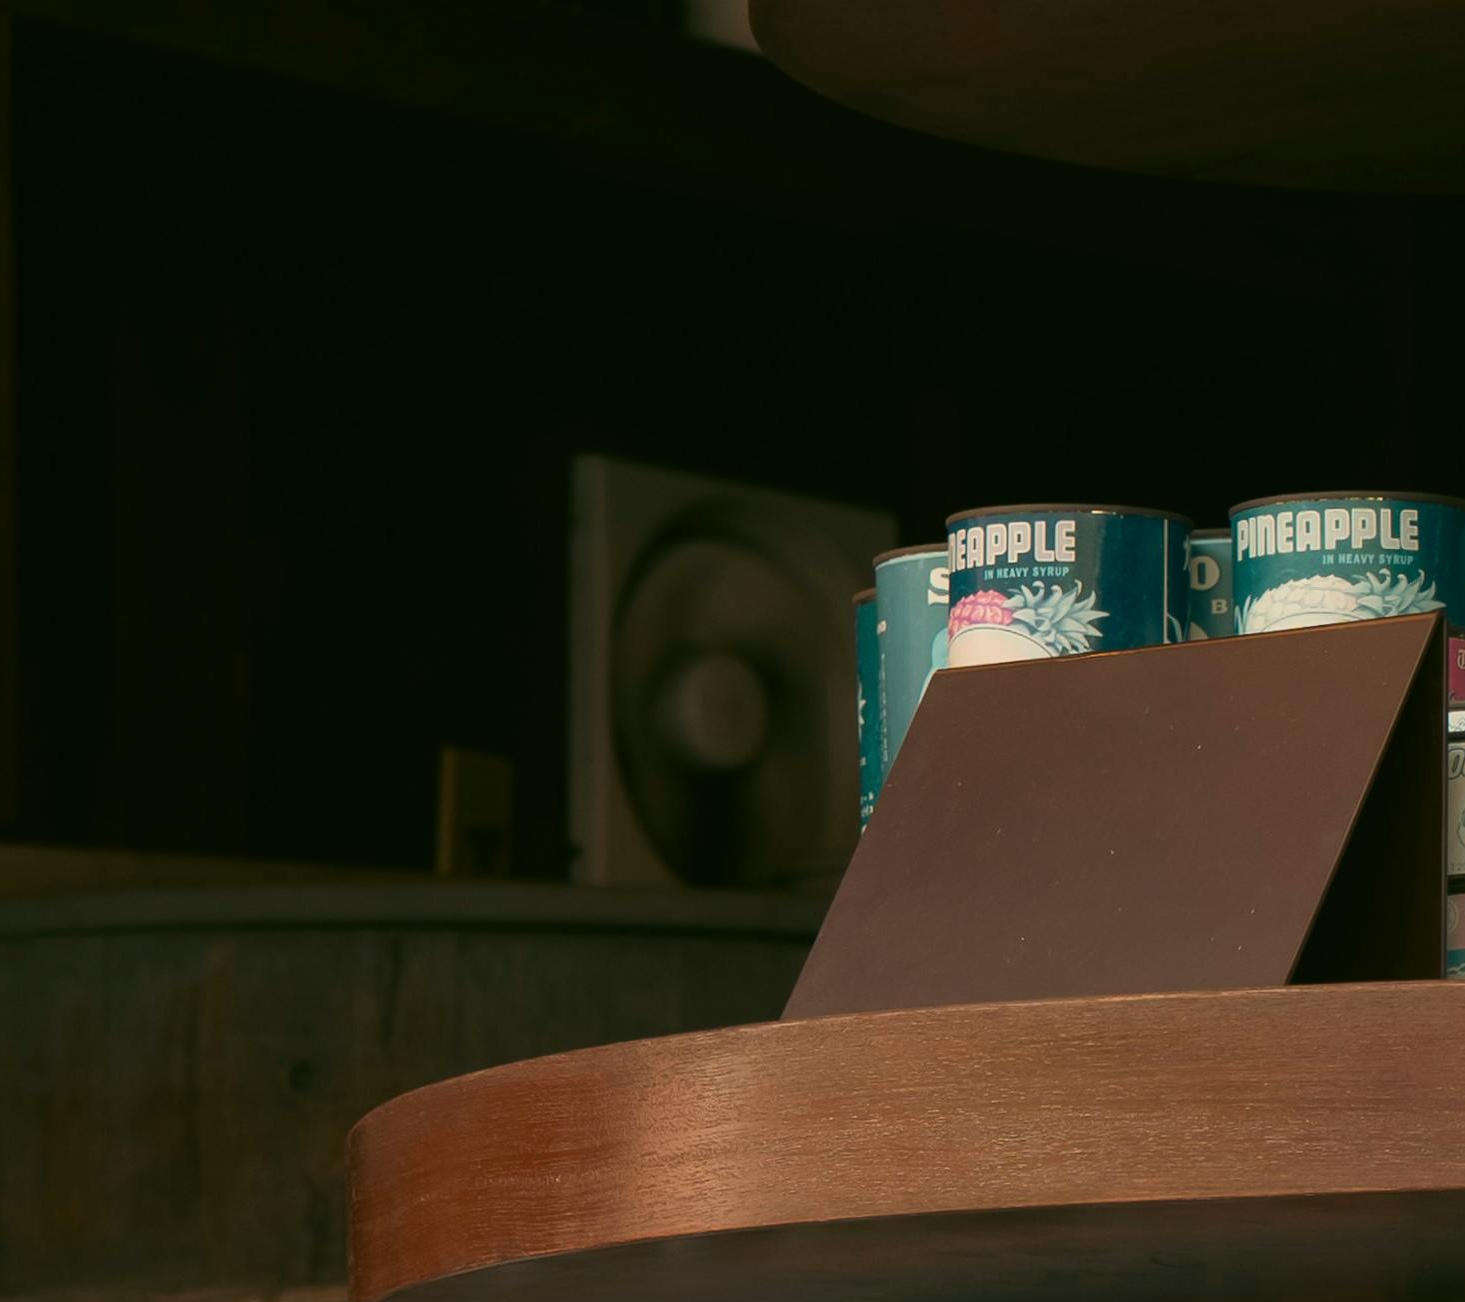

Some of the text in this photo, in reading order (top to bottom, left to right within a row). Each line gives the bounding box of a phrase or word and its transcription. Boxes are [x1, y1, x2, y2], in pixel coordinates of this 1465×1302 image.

[1237, 508, 1419, 562] PINEAPPLE
[1322, 554, 1414, 566] IN HEAVY SYRUP
[984, 566, 1070, 581] IN HEAVY SYRUP
